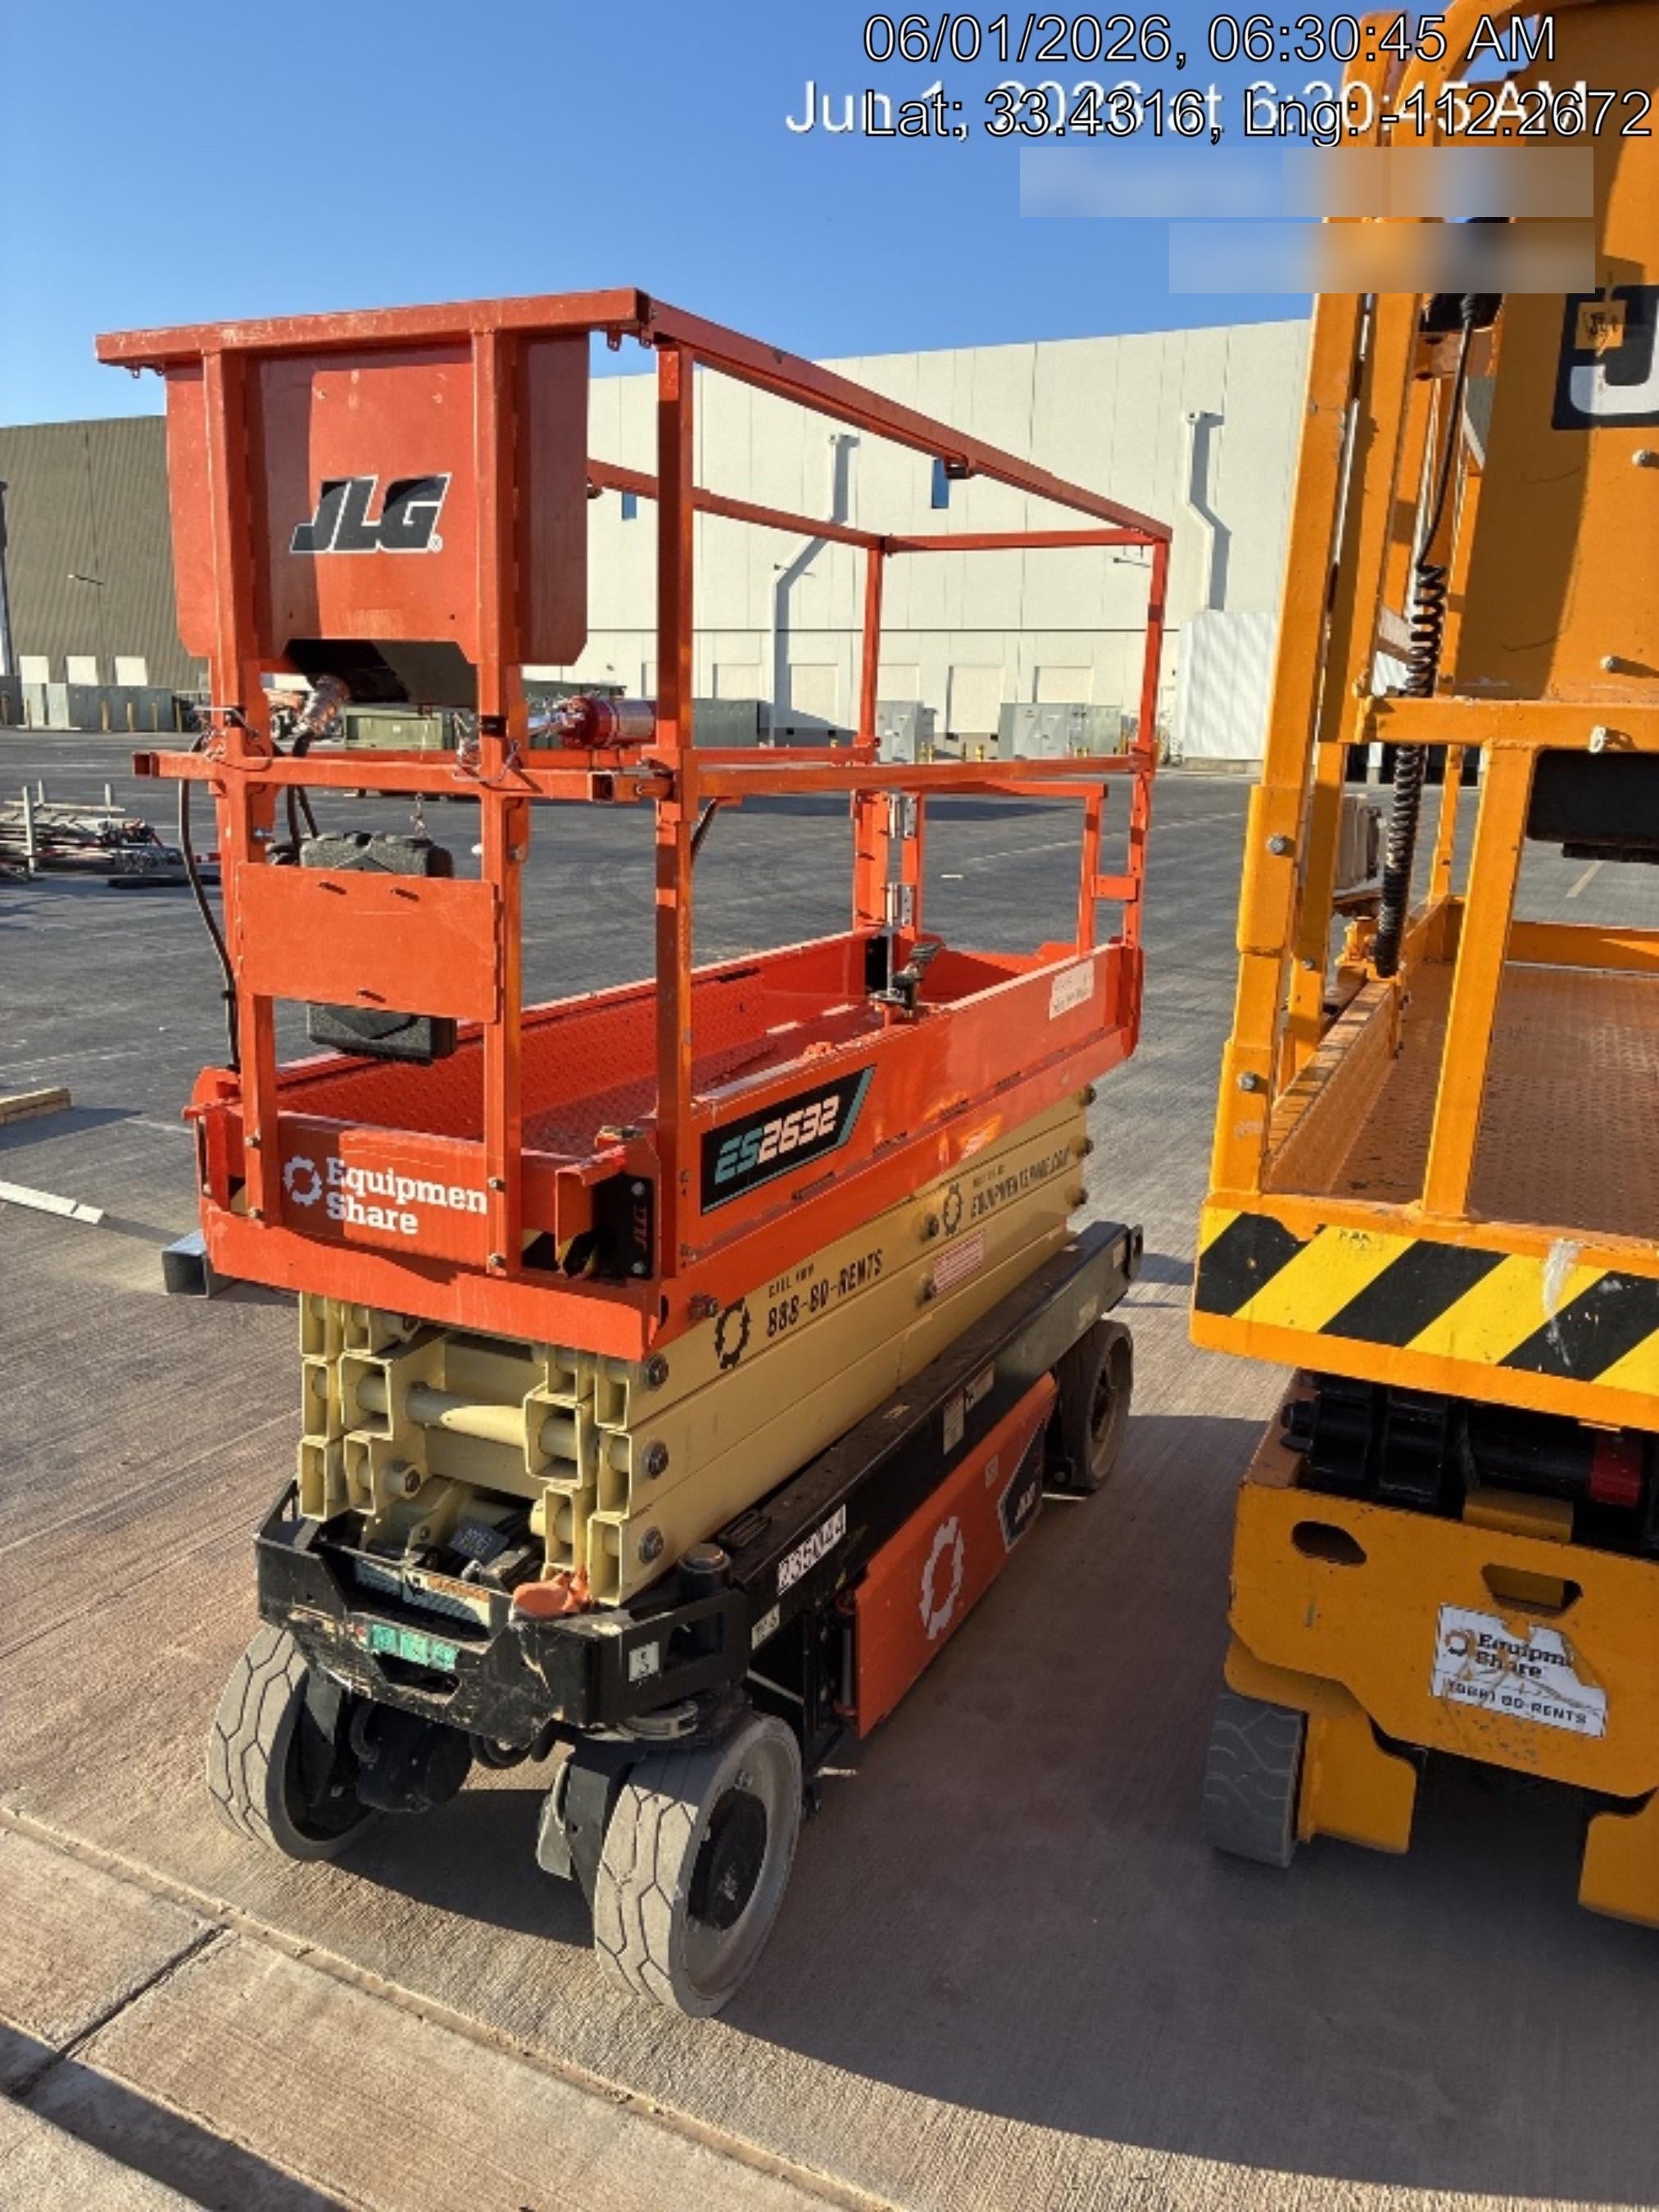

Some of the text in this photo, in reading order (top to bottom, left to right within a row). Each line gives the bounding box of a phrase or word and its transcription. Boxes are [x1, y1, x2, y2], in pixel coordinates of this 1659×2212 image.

[290, 472, 452, 553] JLG
[326, 1156, 487, 1214] Equipmen
[326, 1191, 419, 1235] Share
